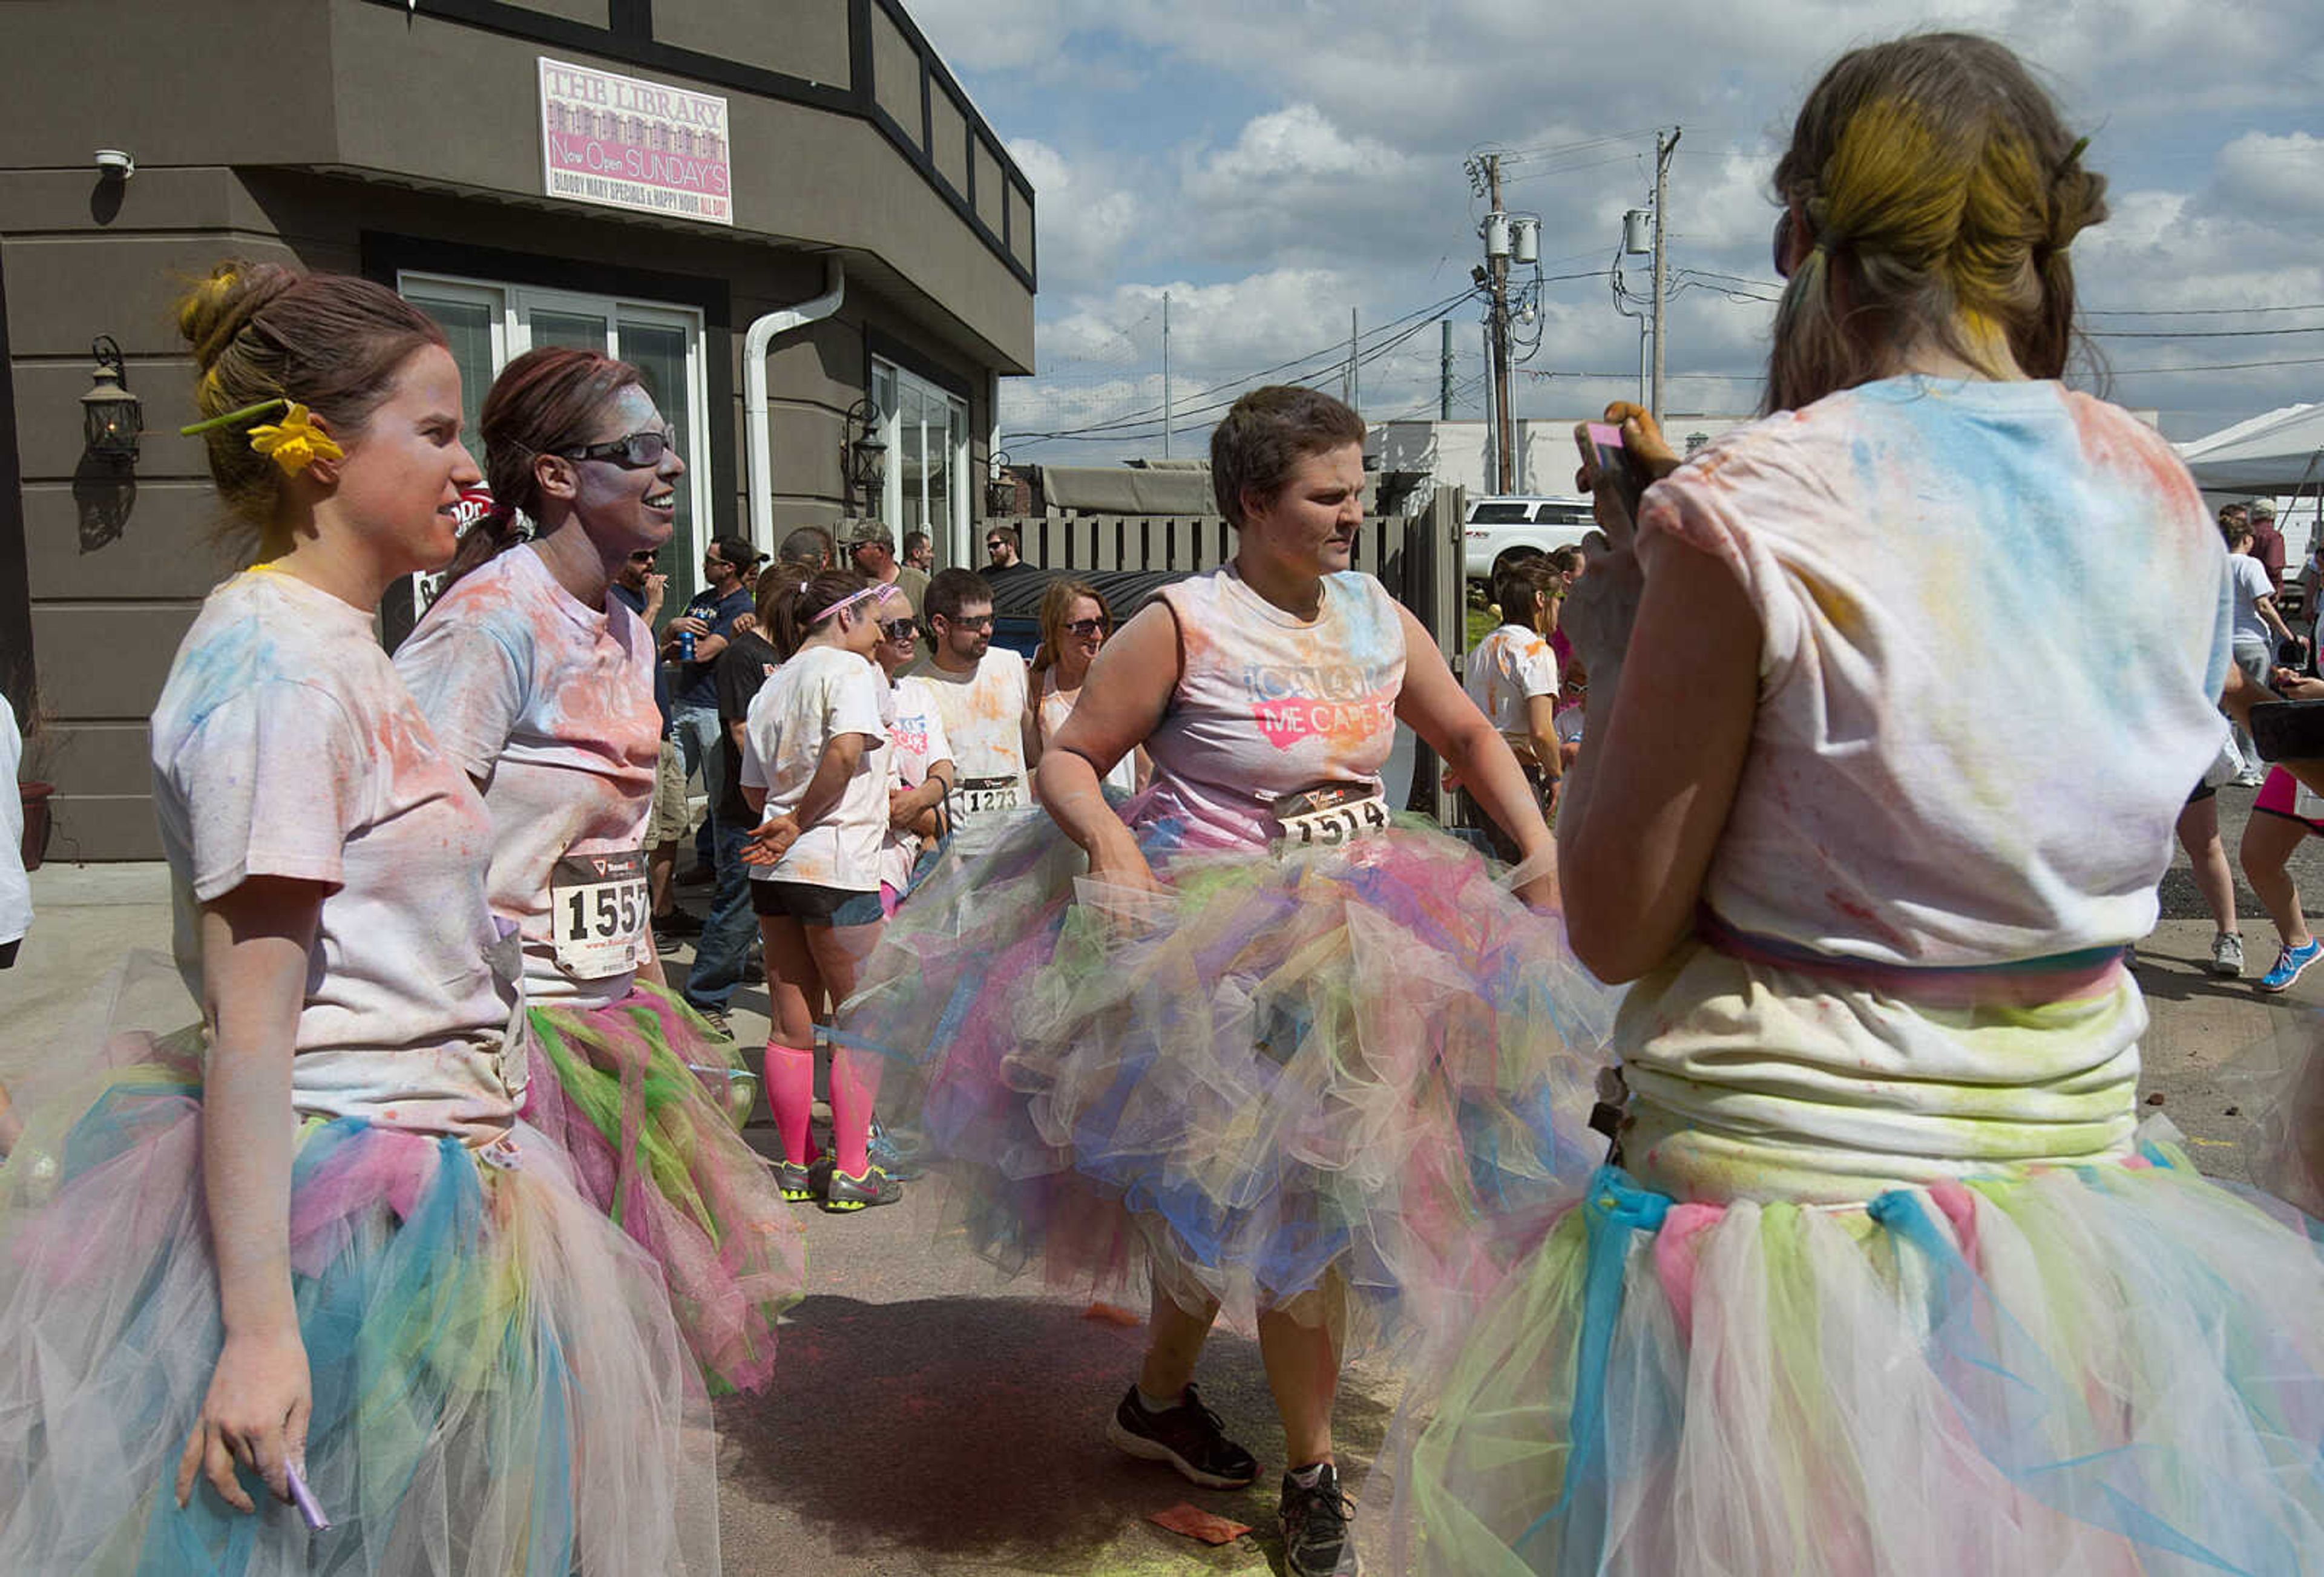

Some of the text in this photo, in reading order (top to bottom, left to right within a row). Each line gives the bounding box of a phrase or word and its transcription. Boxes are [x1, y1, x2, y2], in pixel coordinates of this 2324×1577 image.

[547, 68, 723, 128] THE LIBRARY
[970, 790, 1018, 813] 1273
[569, 884, 648, 941] 1557
